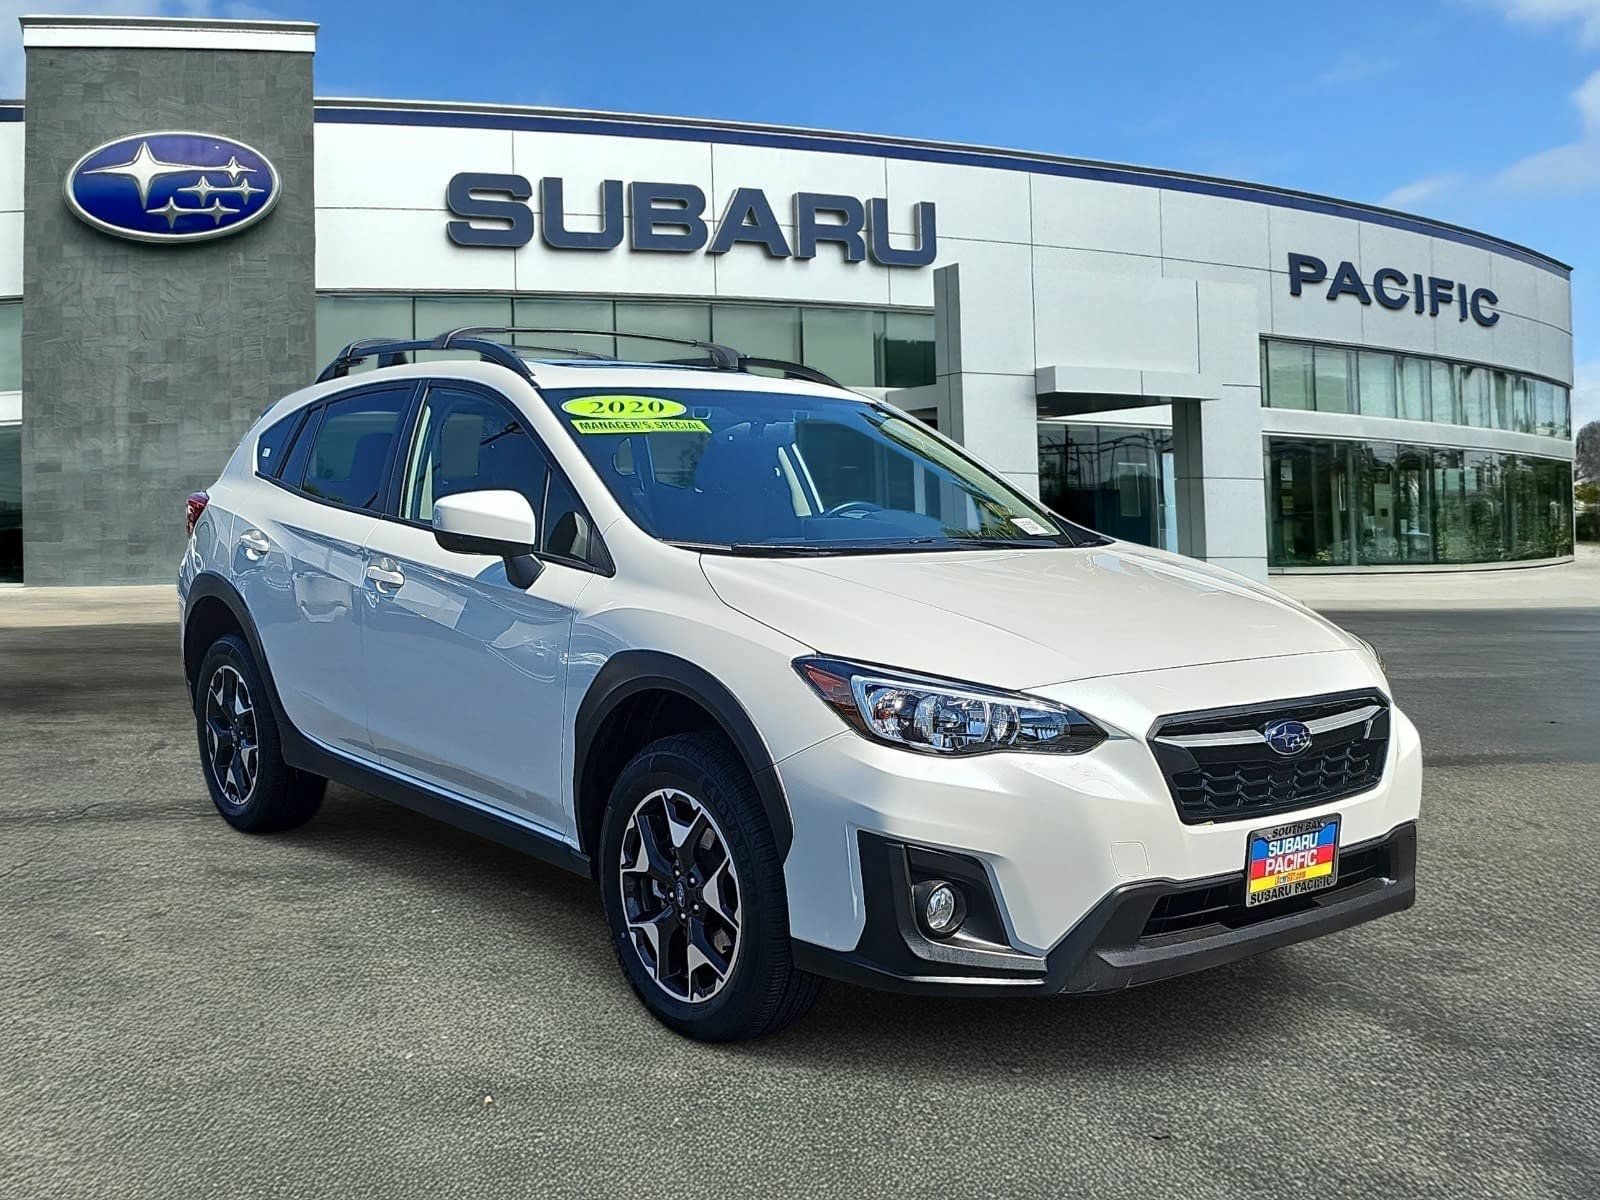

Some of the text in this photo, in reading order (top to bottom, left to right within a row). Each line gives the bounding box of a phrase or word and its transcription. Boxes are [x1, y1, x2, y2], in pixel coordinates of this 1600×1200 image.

[447, 171, 937, 268] SUBARU
[1288, 252, 1500, 327] PACIFIC
[590, 400, 665, 414] 2020
[579, 420, 703, 431] MANAGER'S SPECIAL
[1268, 831, 1319, 857] SUBARU
[1272, 823, 1304, 839] SOUTH
[1264, 849, 1318, 877] PACIFIC
[1250, 884, 1292, 904] SUBARU
[1294, 876, 1334, 894] PACIFIC
